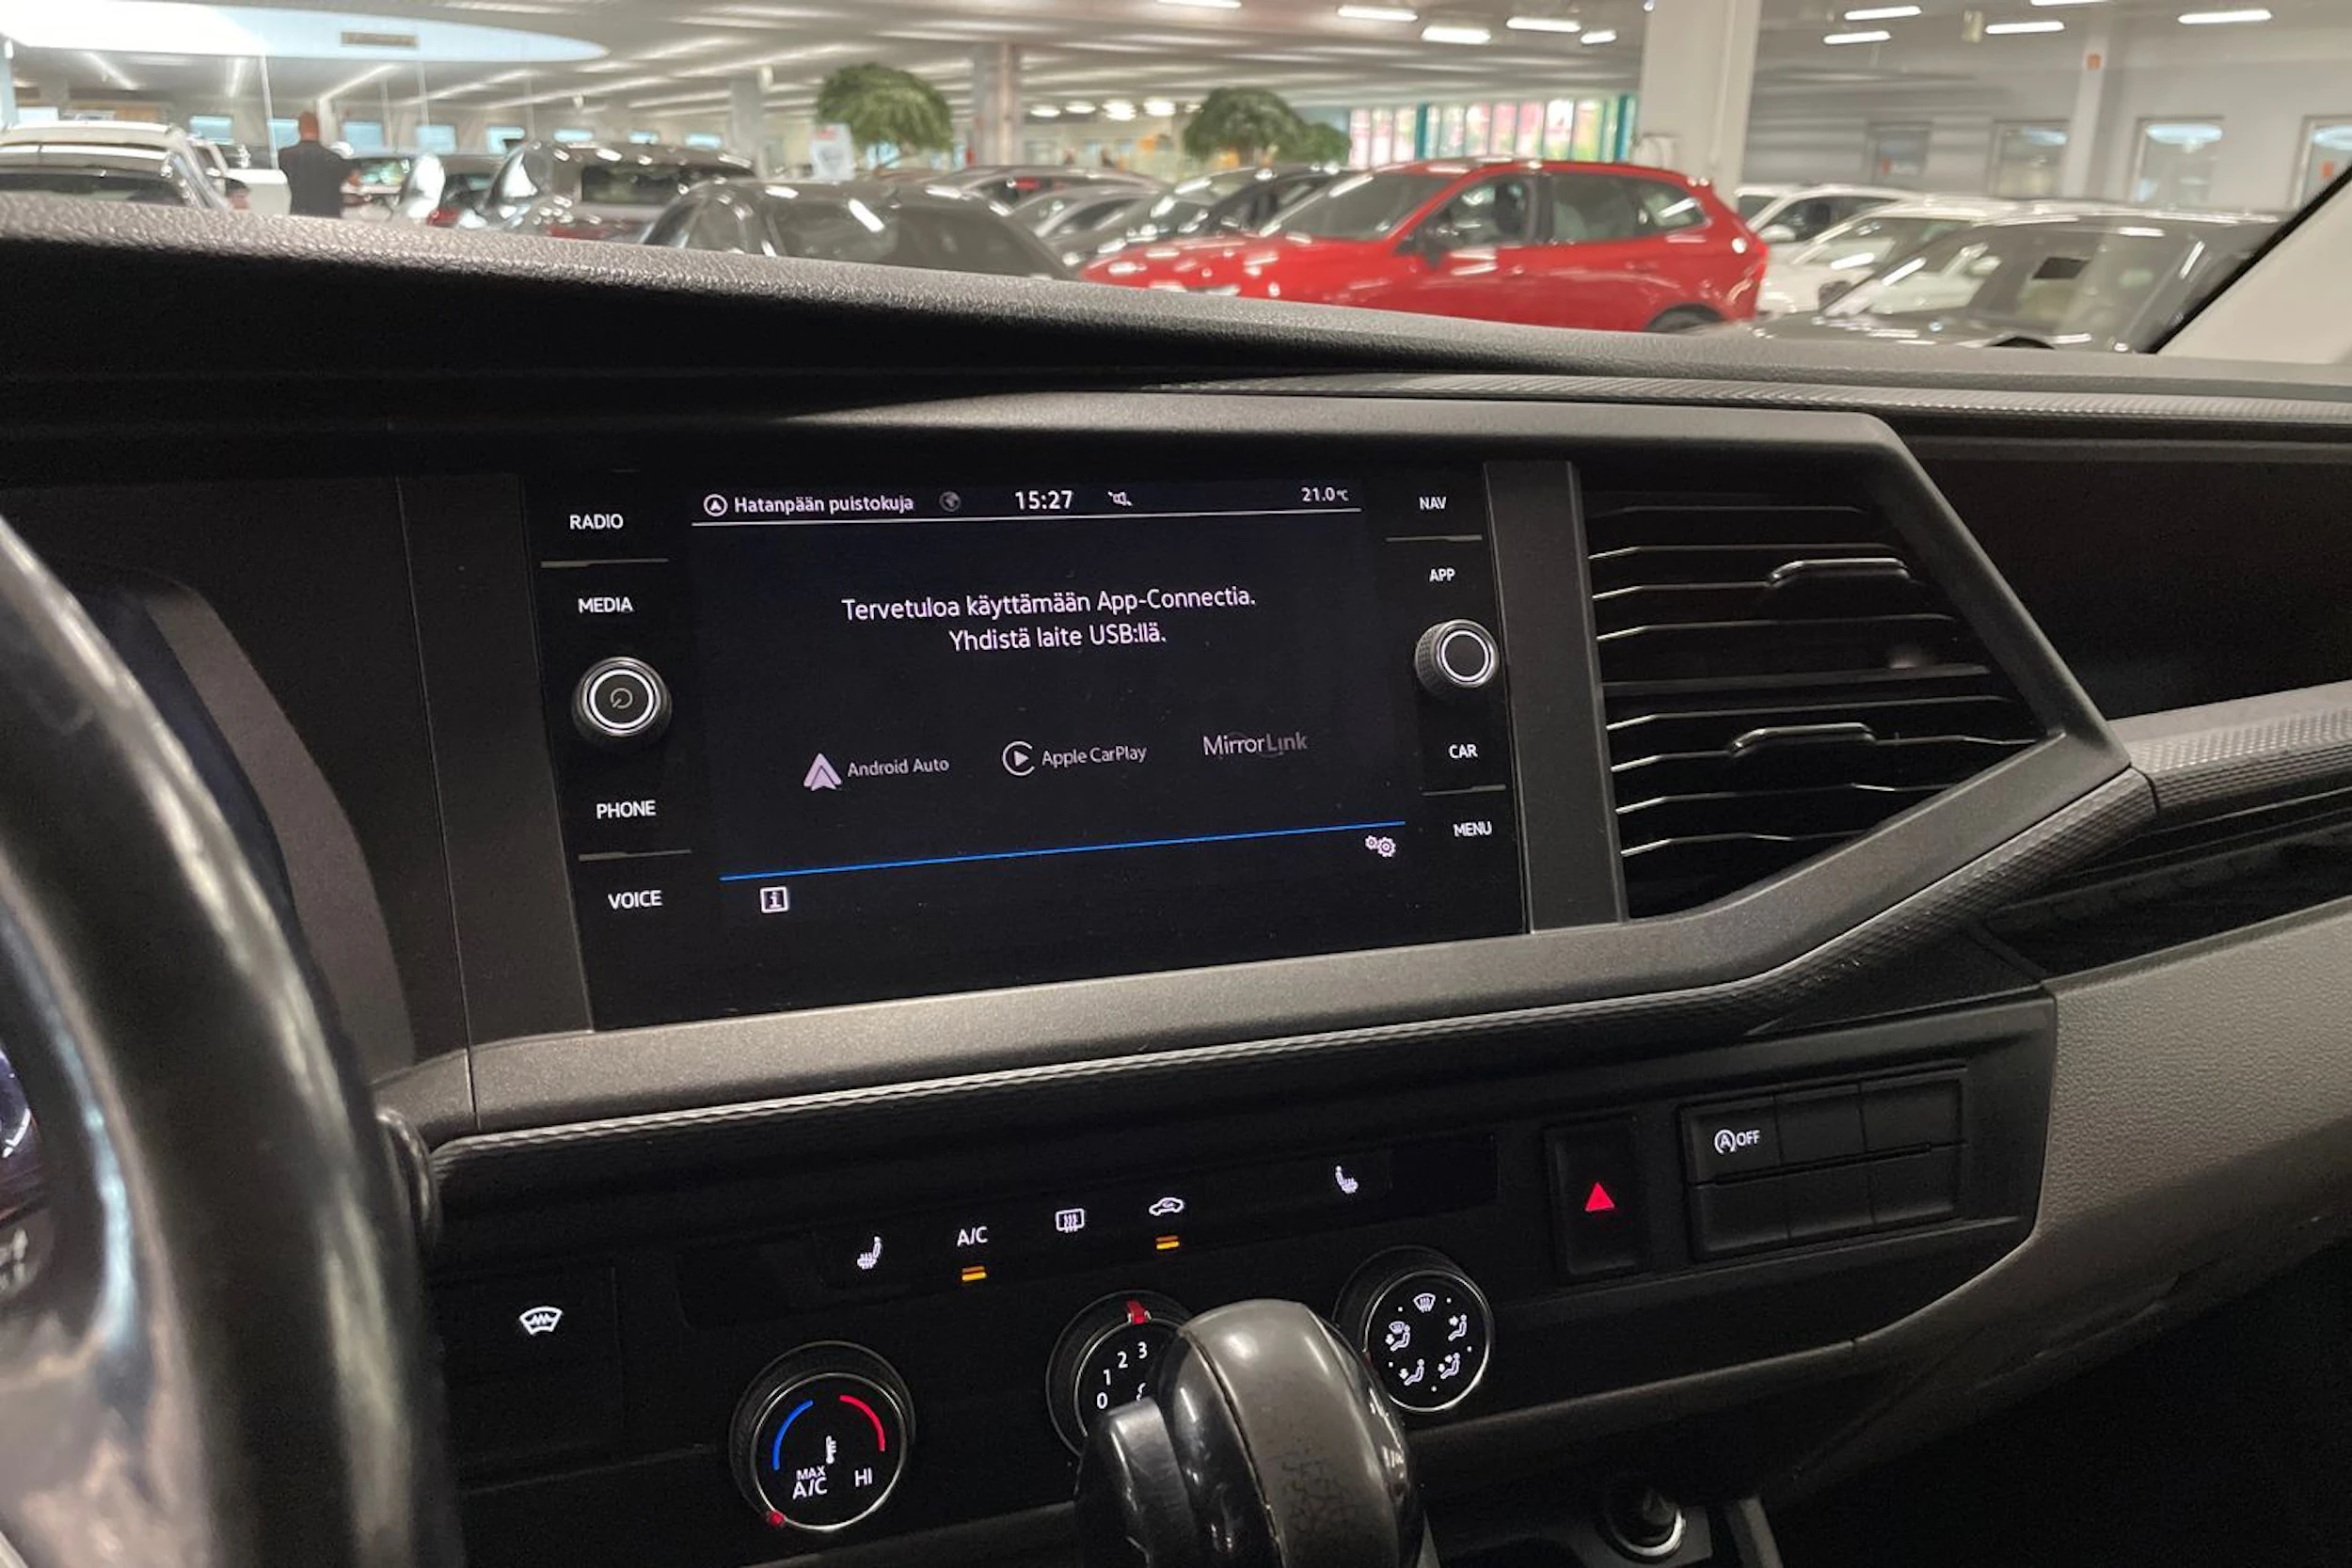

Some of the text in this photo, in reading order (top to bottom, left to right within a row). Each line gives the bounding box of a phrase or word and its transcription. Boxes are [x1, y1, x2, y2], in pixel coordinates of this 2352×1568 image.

[734, 494, 914, 515] Hatanpään puistokuja
[1014, 489, 1073, 510] 15:27
[1419, 496, 1447, 511] NAV
[569, 514, 624, 530] RADIO
[1429, 567, 1456, 582] APP
[578, 596, 634, 614] MEDIA
[841, 585, 1256, 621] Tervetuloa käyttämään App-Connectia.
[948, 622, 1167, 652] Yhdistä laite USB:llä.
[1202, 731, 1308, 756] MirrorLink
[1449, 743, 1479, 759] CAR
[1041, 745, 1147, 768] Apple CarPlay
[847, 757, 950, 778] Android Auto
[596, 800, 657, 820] PHONE
[1453, 820, 1493, 837] MENU
[608, 889, 663, 910] VOICE
[1737, 1130, 1760, 1146] OFF
[957, 1226, 988, 1247] A/C
[1137, 1341, 1148, 1359] 3
[1117, 1351, 1129, 1369] 2
[1104, 1369, 1111, 1386] 1
[1096, 1392, 1108, 1409] 0
[796, 1465, 826, 1481] MAX
[854, 1467, 873, 1488] HI
[792, 1477, 828, 1500] A/C
